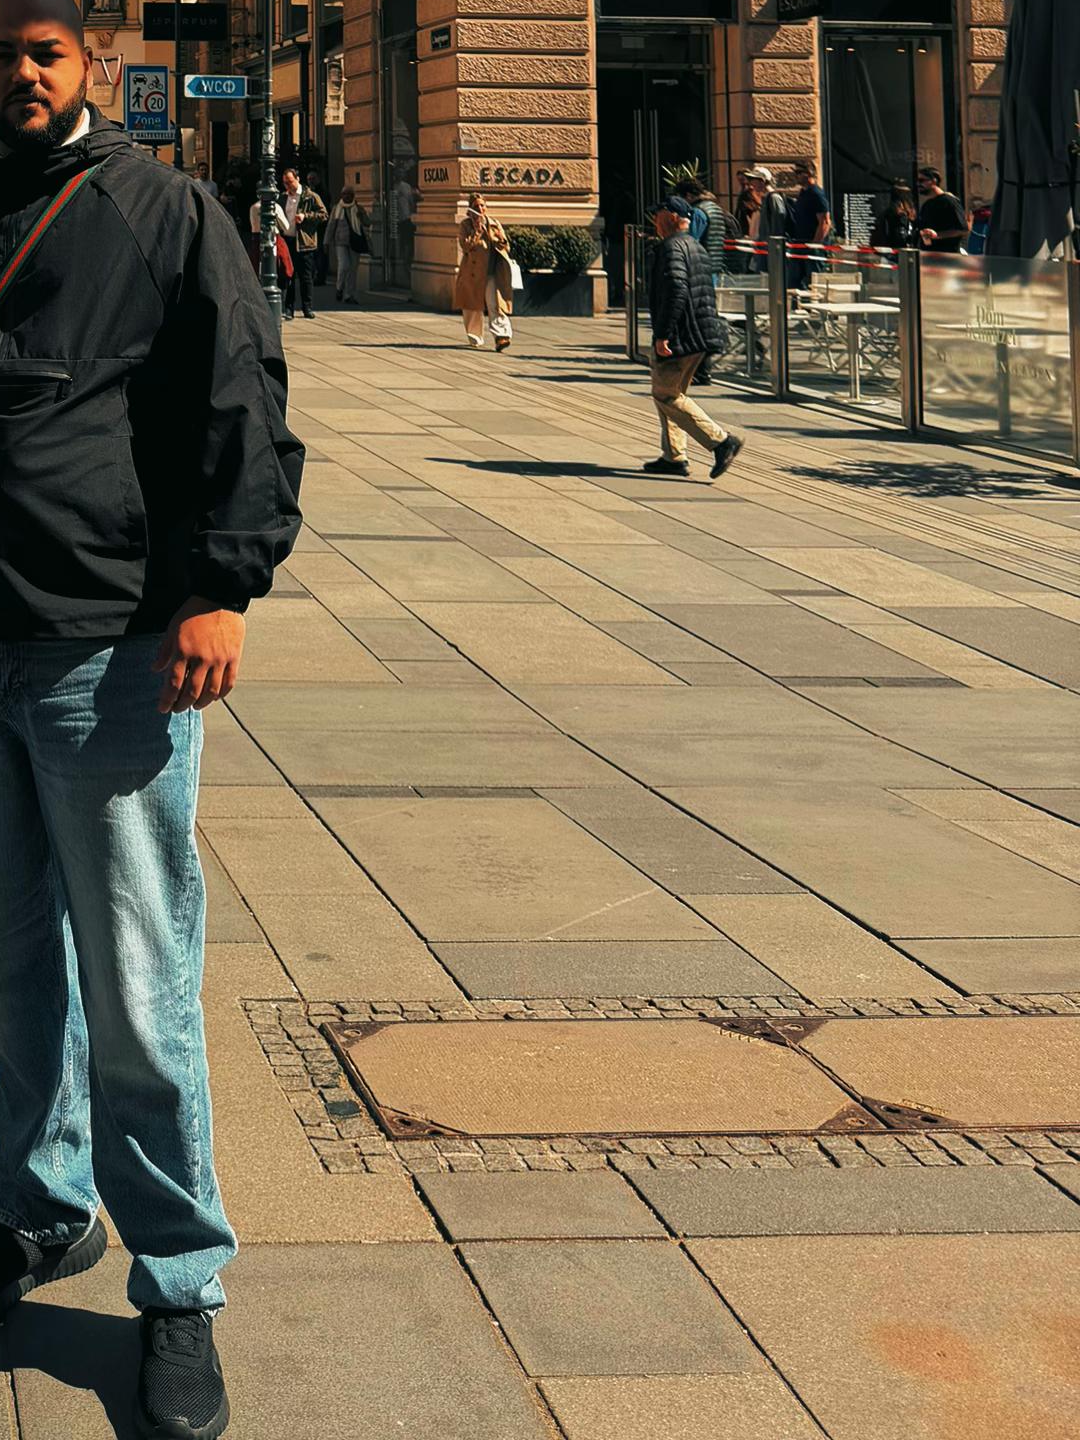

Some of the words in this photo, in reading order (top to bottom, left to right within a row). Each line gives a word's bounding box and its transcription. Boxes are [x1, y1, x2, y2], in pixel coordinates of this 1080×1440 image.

[201, 80, 223, 93] WC
[151, 97, 164, 110] 20
[134, 115, 162, 126] Zone
[423, 167, 449, 183] ESCADA
[478, 167, 565, 186] ESCADA
